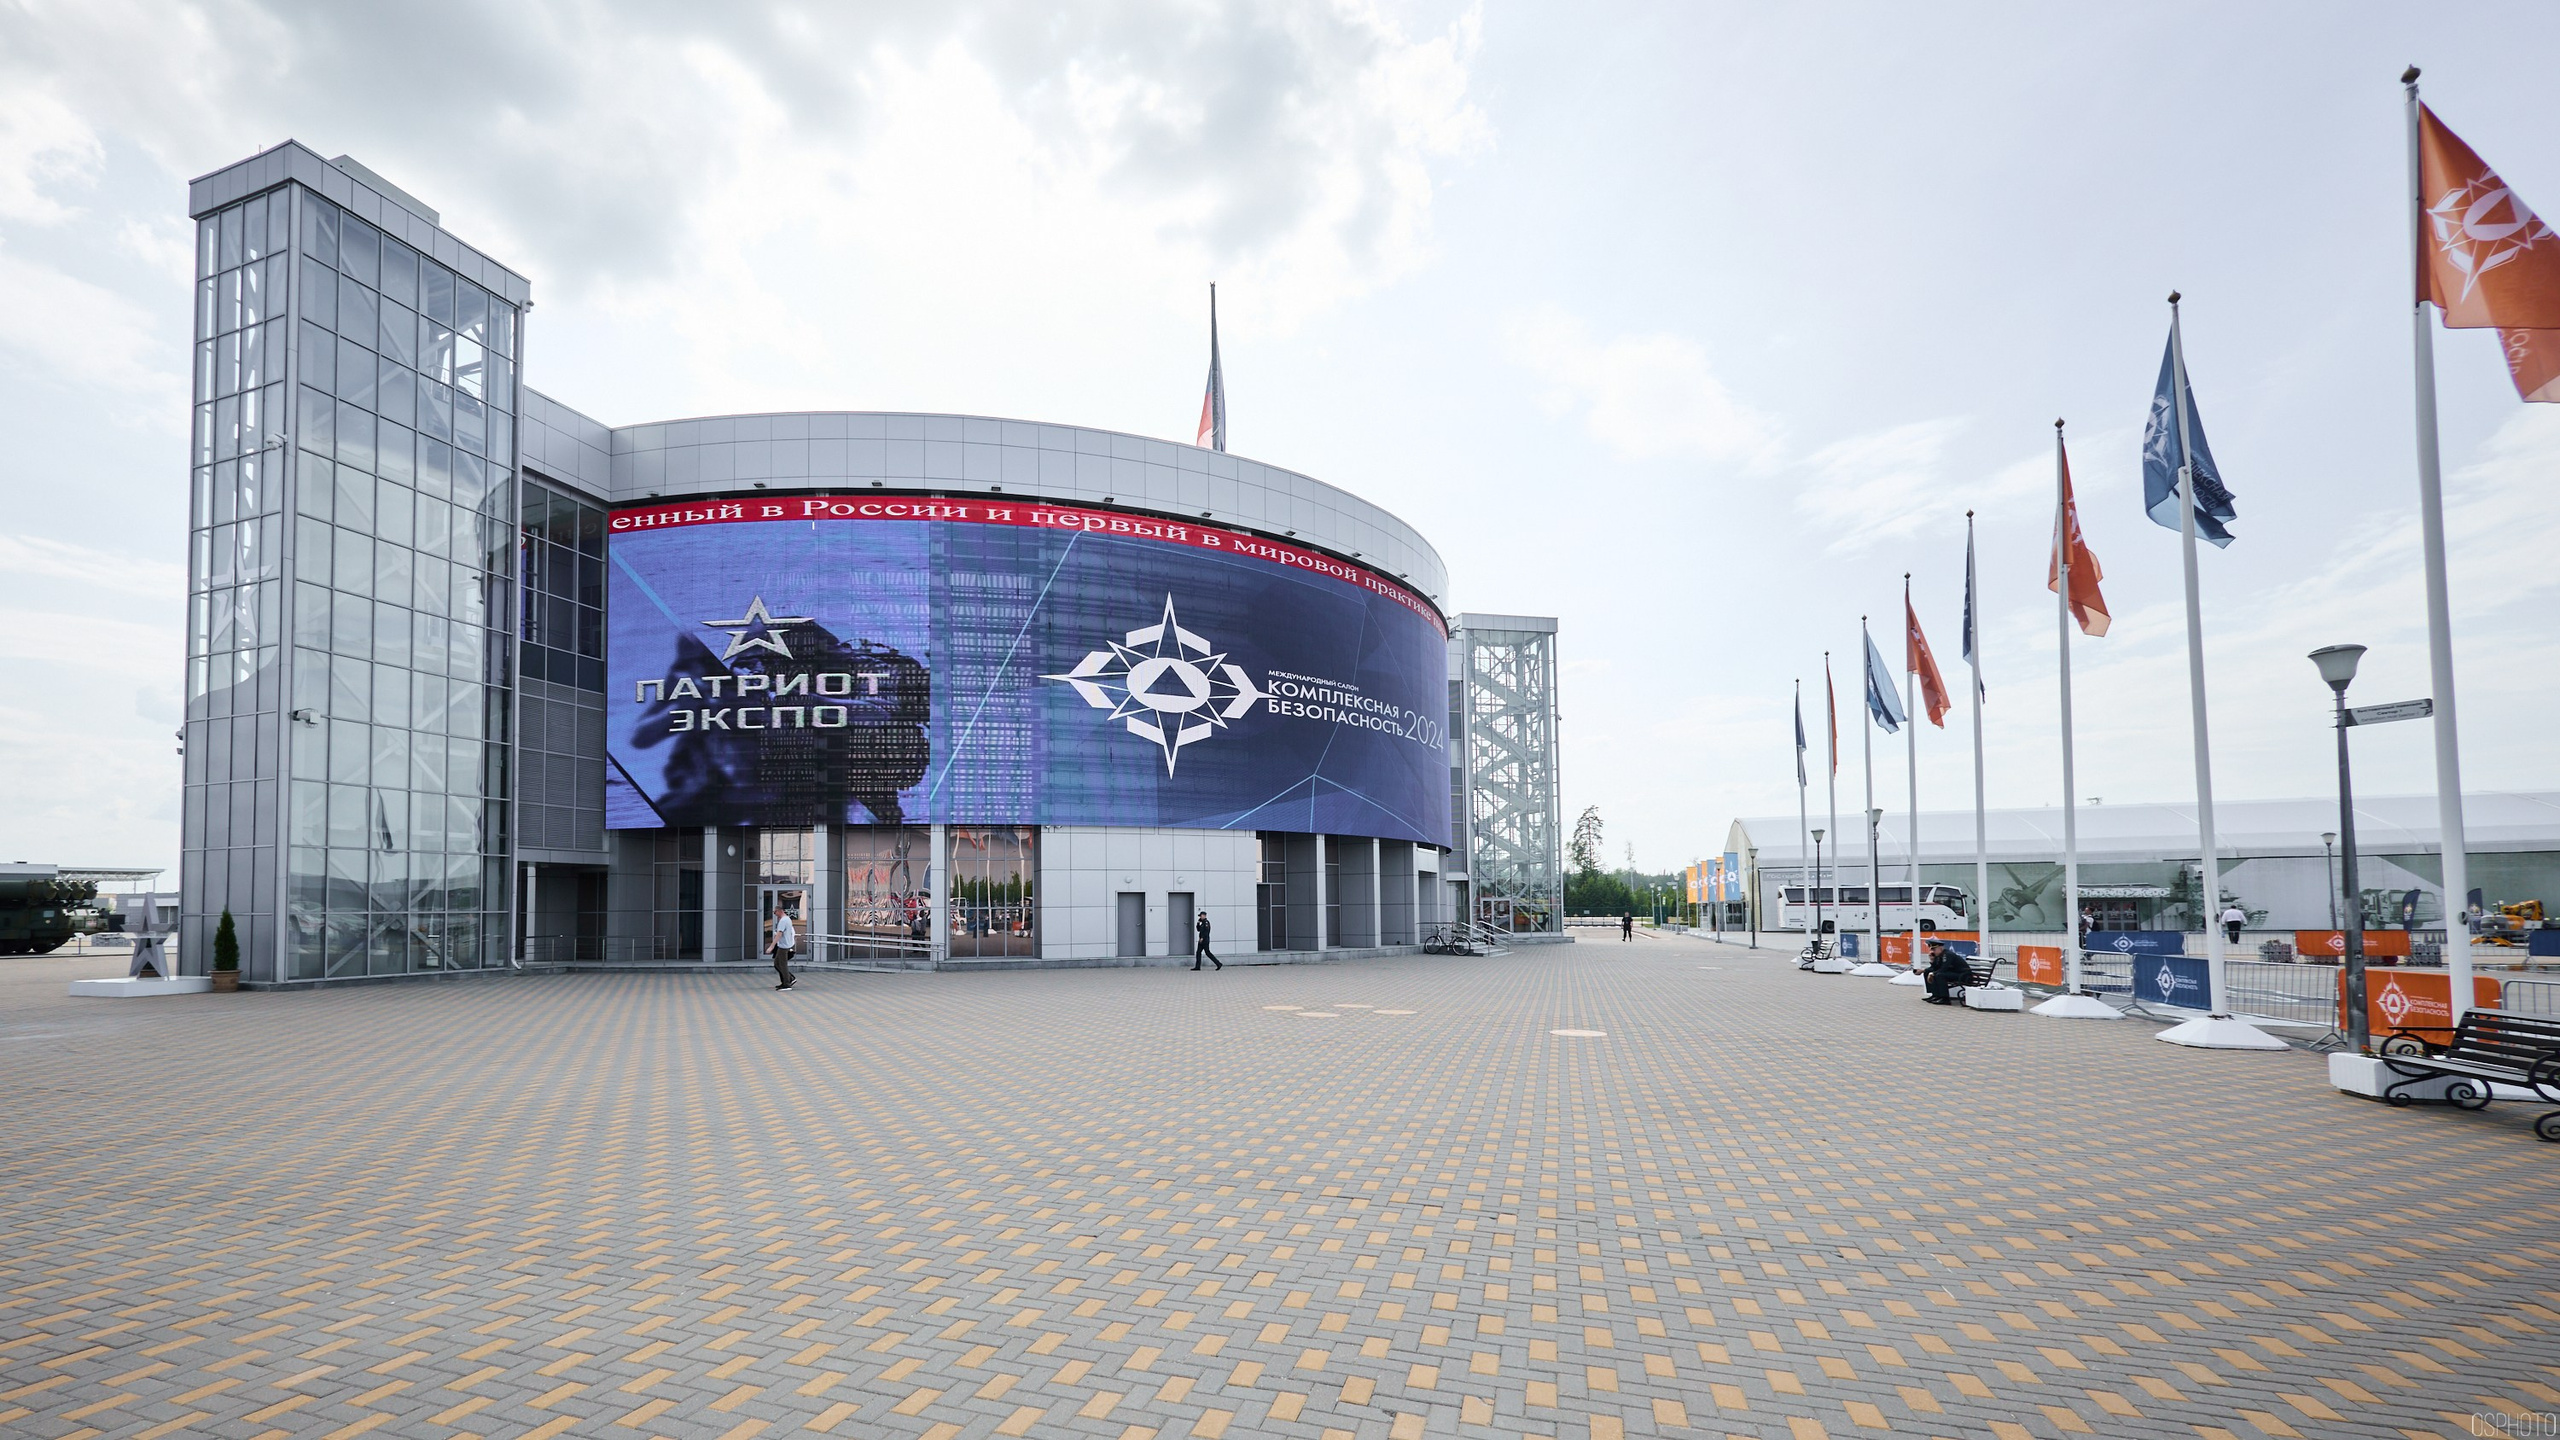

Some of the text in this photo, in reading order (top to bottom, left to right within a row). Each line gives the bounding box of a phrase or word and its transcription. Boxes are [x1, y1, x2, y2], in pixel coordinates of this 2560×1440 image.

[611, 500, 1432, 621] енный в России и первый в мировой практике
[635, 672, 890, 703] ПАТРИОТ
[1268, 669, 1359, 693] МЕЖДУНАРОДНЫЙ САЛОН
[1268, 680, 1399, 719] КОМПЛЕКСНАЯ
[669, 705, 848, 732] ЭКСПО
[1268, 699, 1444, 753] БЕЗОПАСНОСТЬ 2024
